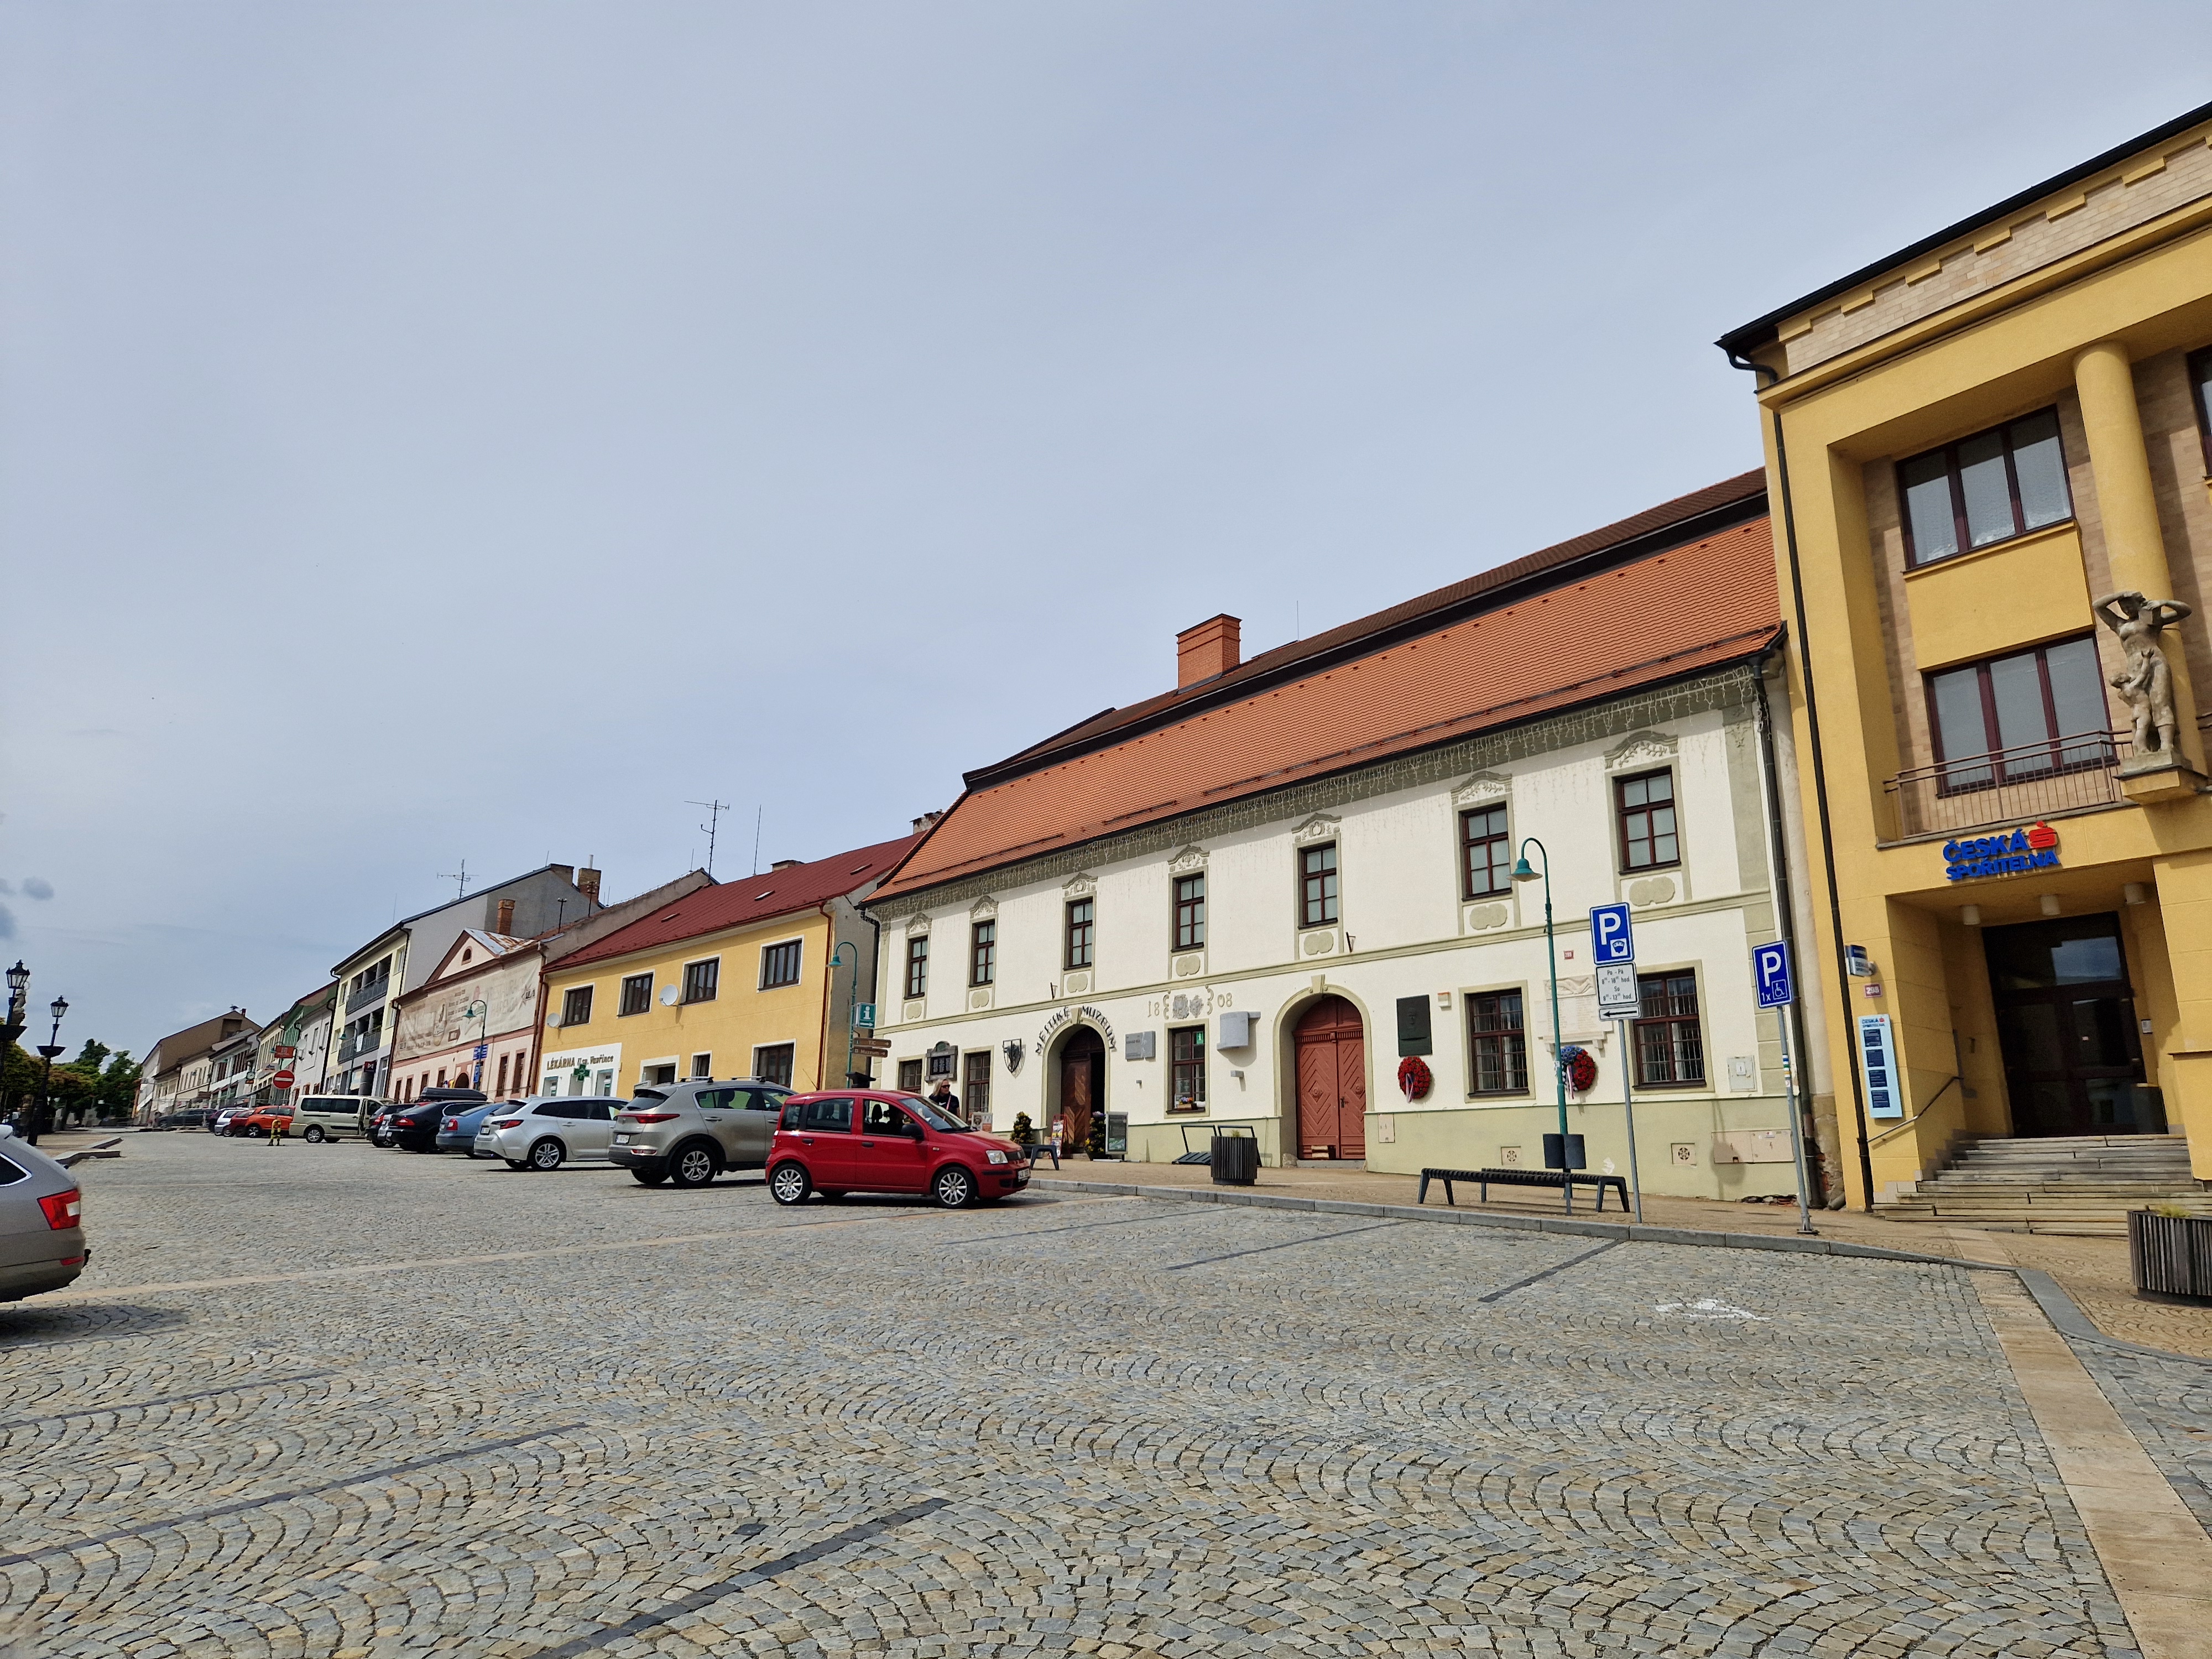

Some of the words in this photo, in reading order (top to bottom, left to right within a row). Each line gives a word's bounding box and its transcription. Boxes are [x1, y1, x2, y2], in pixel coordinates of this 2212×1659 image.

[1943, 828, 2029, 862] ČESKÁ
[1946, 850, 2059, 880] SPOŘITELNA
[1598, 912, 1621, 945] P
[1762, 951, 1781, 988] P
[1082, 1005, 1116, 1050] MUZEUM
[547, 1056, 575, 1070] LÉKÁRNA
